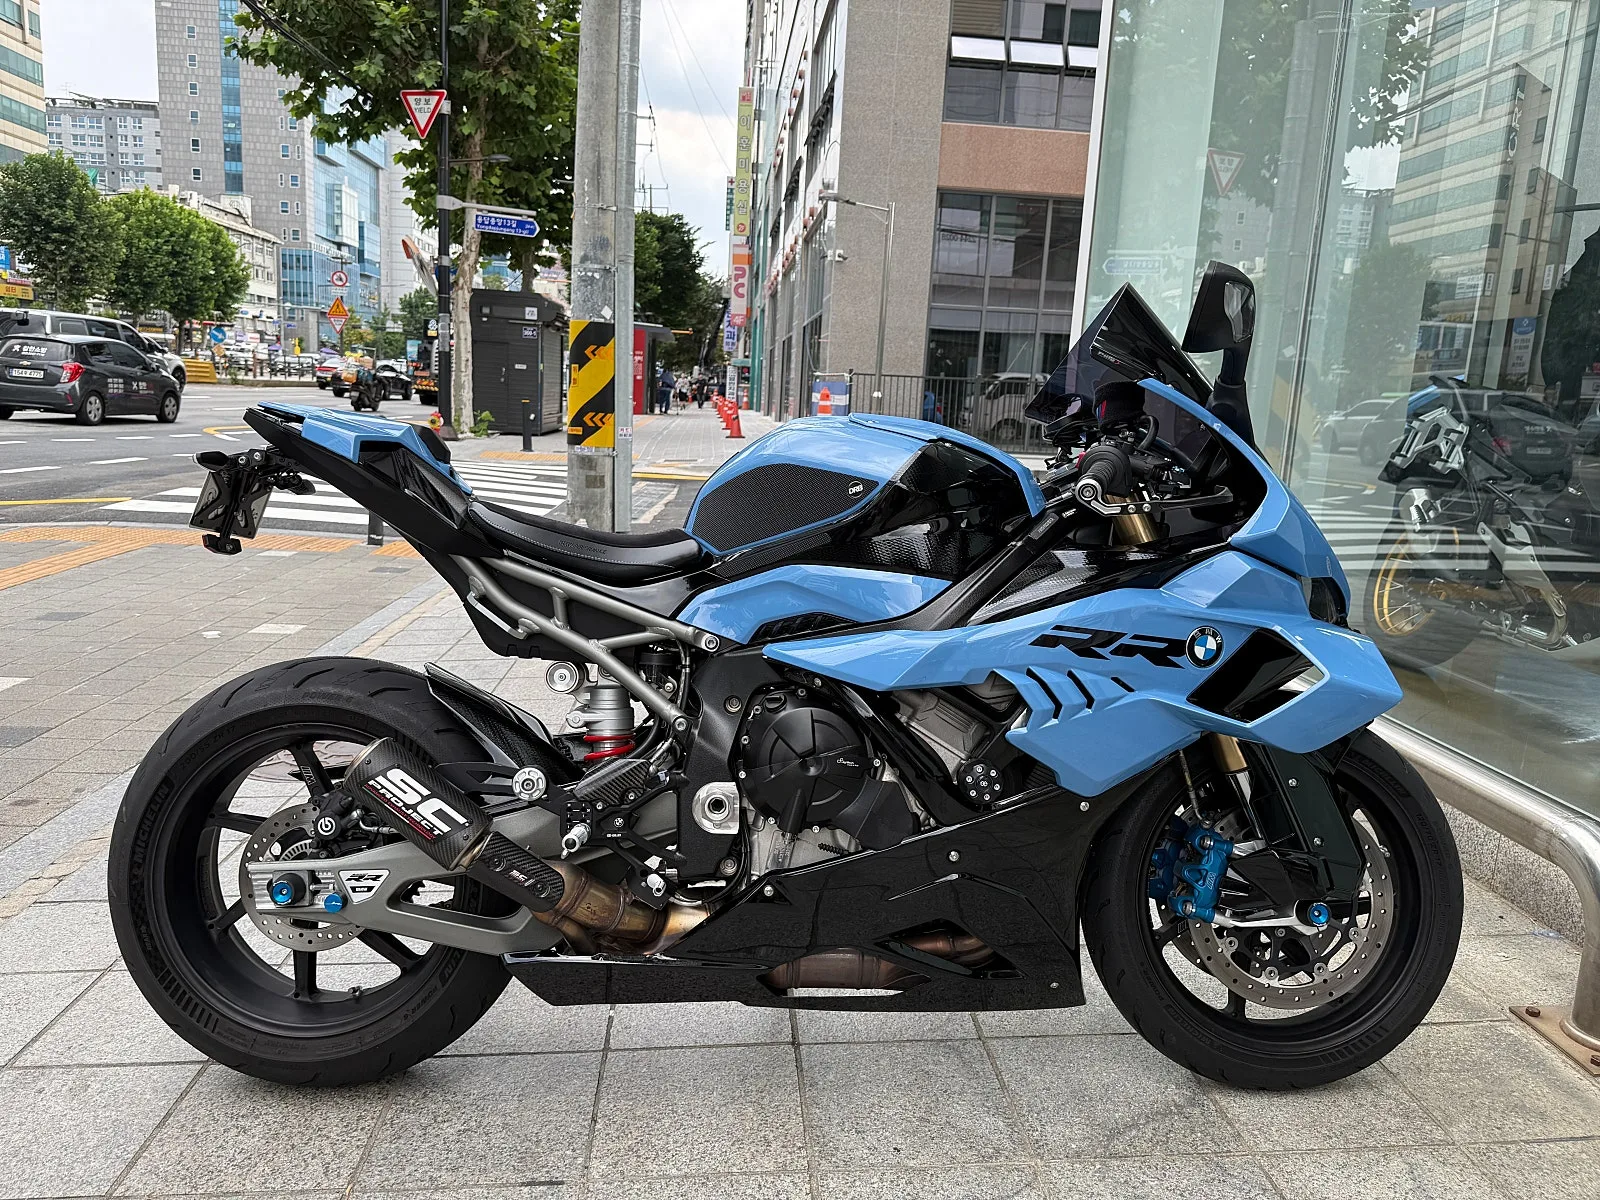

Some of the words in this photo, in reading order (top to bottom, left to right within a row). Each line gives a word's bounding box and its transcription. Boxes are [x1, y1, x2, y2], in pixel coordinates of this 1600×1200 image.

[737, 114, 751, 215] 이훈미용실
[733, 266, 747, 299] PC
[733, 316, 745, 326] 4F
[848, 484, 864, 495] DRB
[1193, 628, 1222, 643] BMW
[133, 783, 169, 863] MICHELIN
[367, 780, 444, 836] PROJECT
[372, 768, 470, 835] SC
